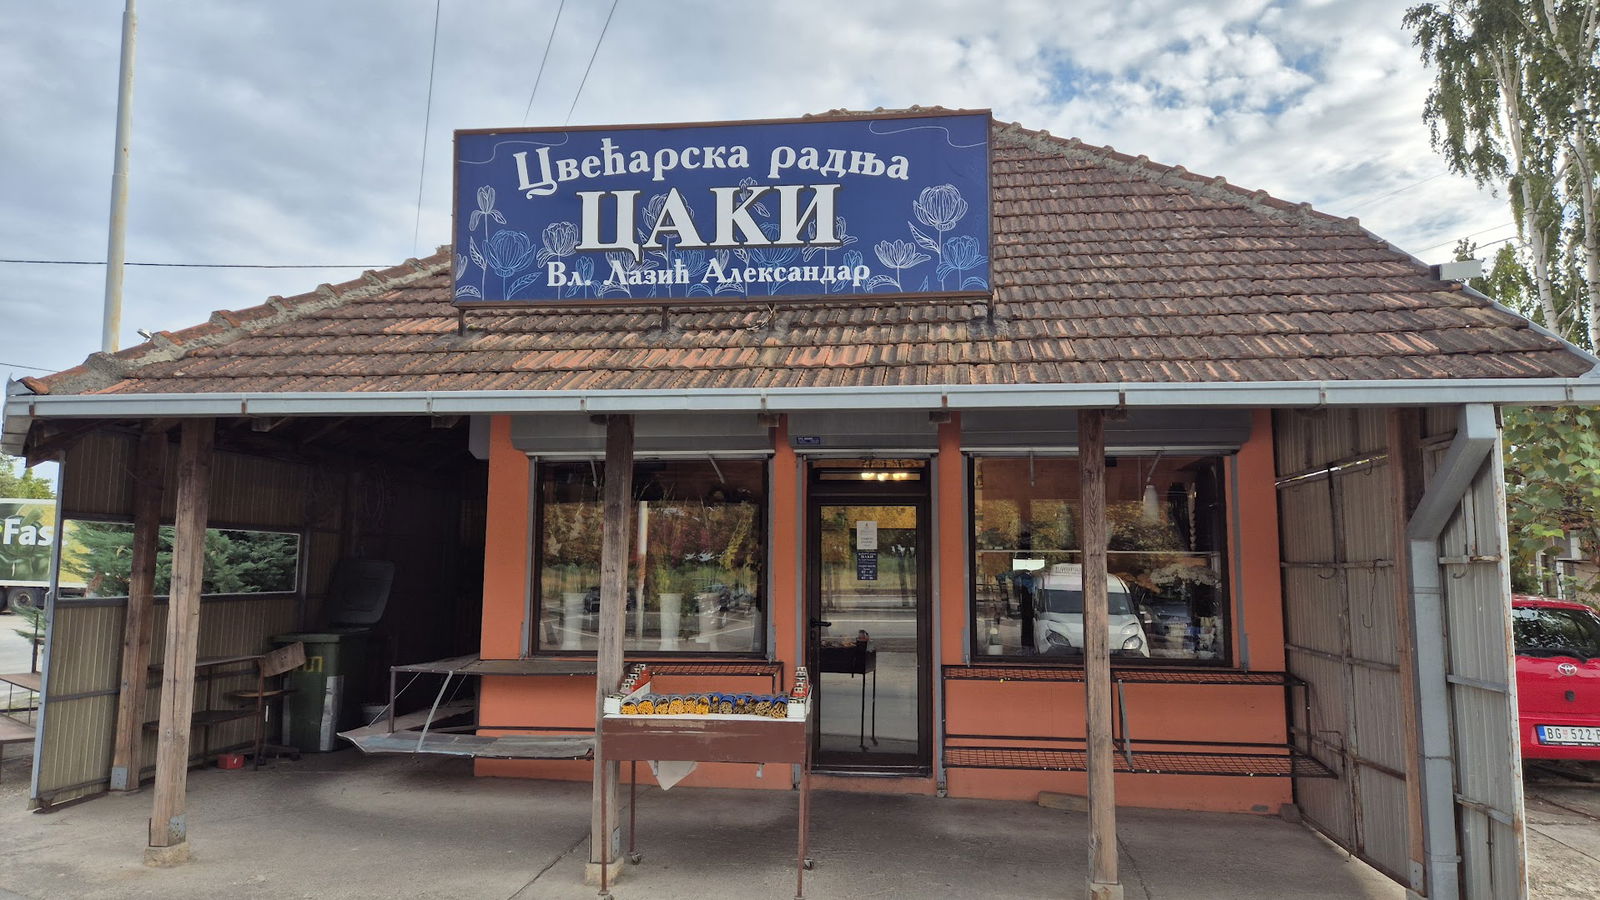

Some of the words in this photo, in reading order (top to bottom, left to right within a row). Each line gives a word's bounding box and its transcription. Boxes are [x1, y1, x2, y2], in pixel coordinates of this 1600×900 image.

[513, 138, 750, 199] Цвећарска
[767, 147, 907, 181] радња
[576, 184, 843, 263] ЦАКИ
[547, 263, 593, 288] Вл.
[603, 261, 691, 287] Лазић
[700, 259, 872, 288] Александар
[1547, 728, 1562, 739] BG
